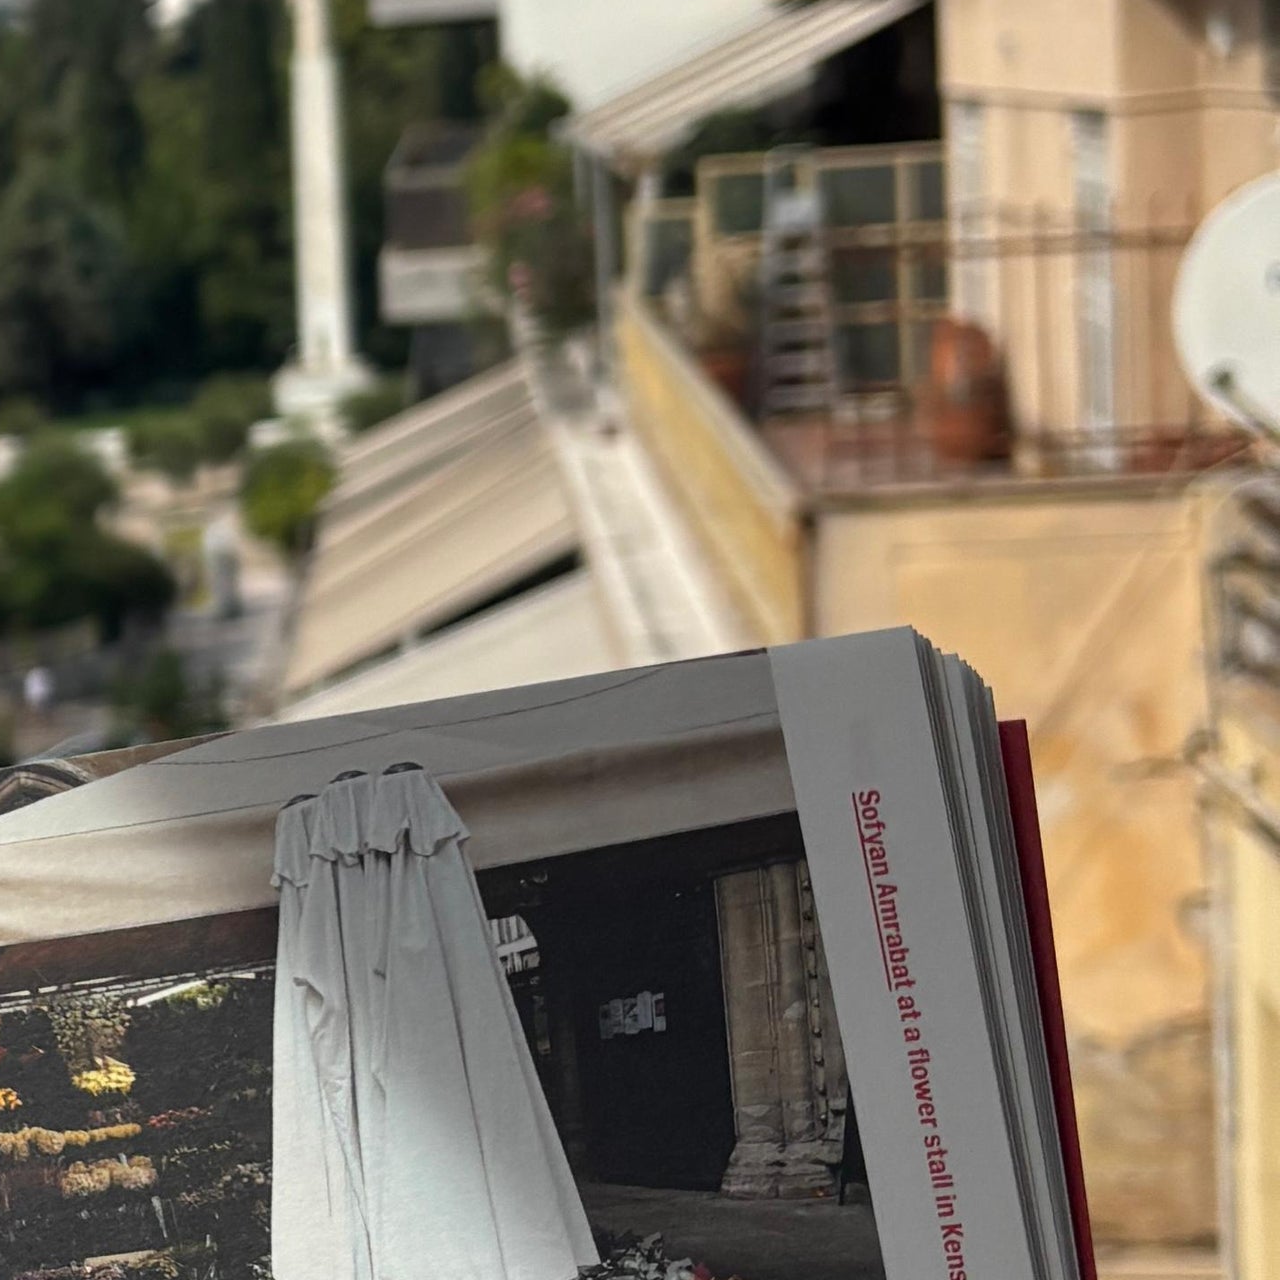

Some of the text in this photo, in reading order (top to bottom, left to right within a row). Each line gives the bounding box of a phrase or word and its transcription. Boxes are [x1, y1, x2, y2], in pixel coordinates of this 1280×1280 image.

[857, 790, 889, 877] Sofyan
[875, 883, 917, 991] Amrabat
[897, 995, 921, 1022] at
[904, 1026, 920, 1042] a
[907, 1047, 937, 1128] flower
[924, 1134, 954, 1189] stall
[935, 1193, 957, 1218] in
